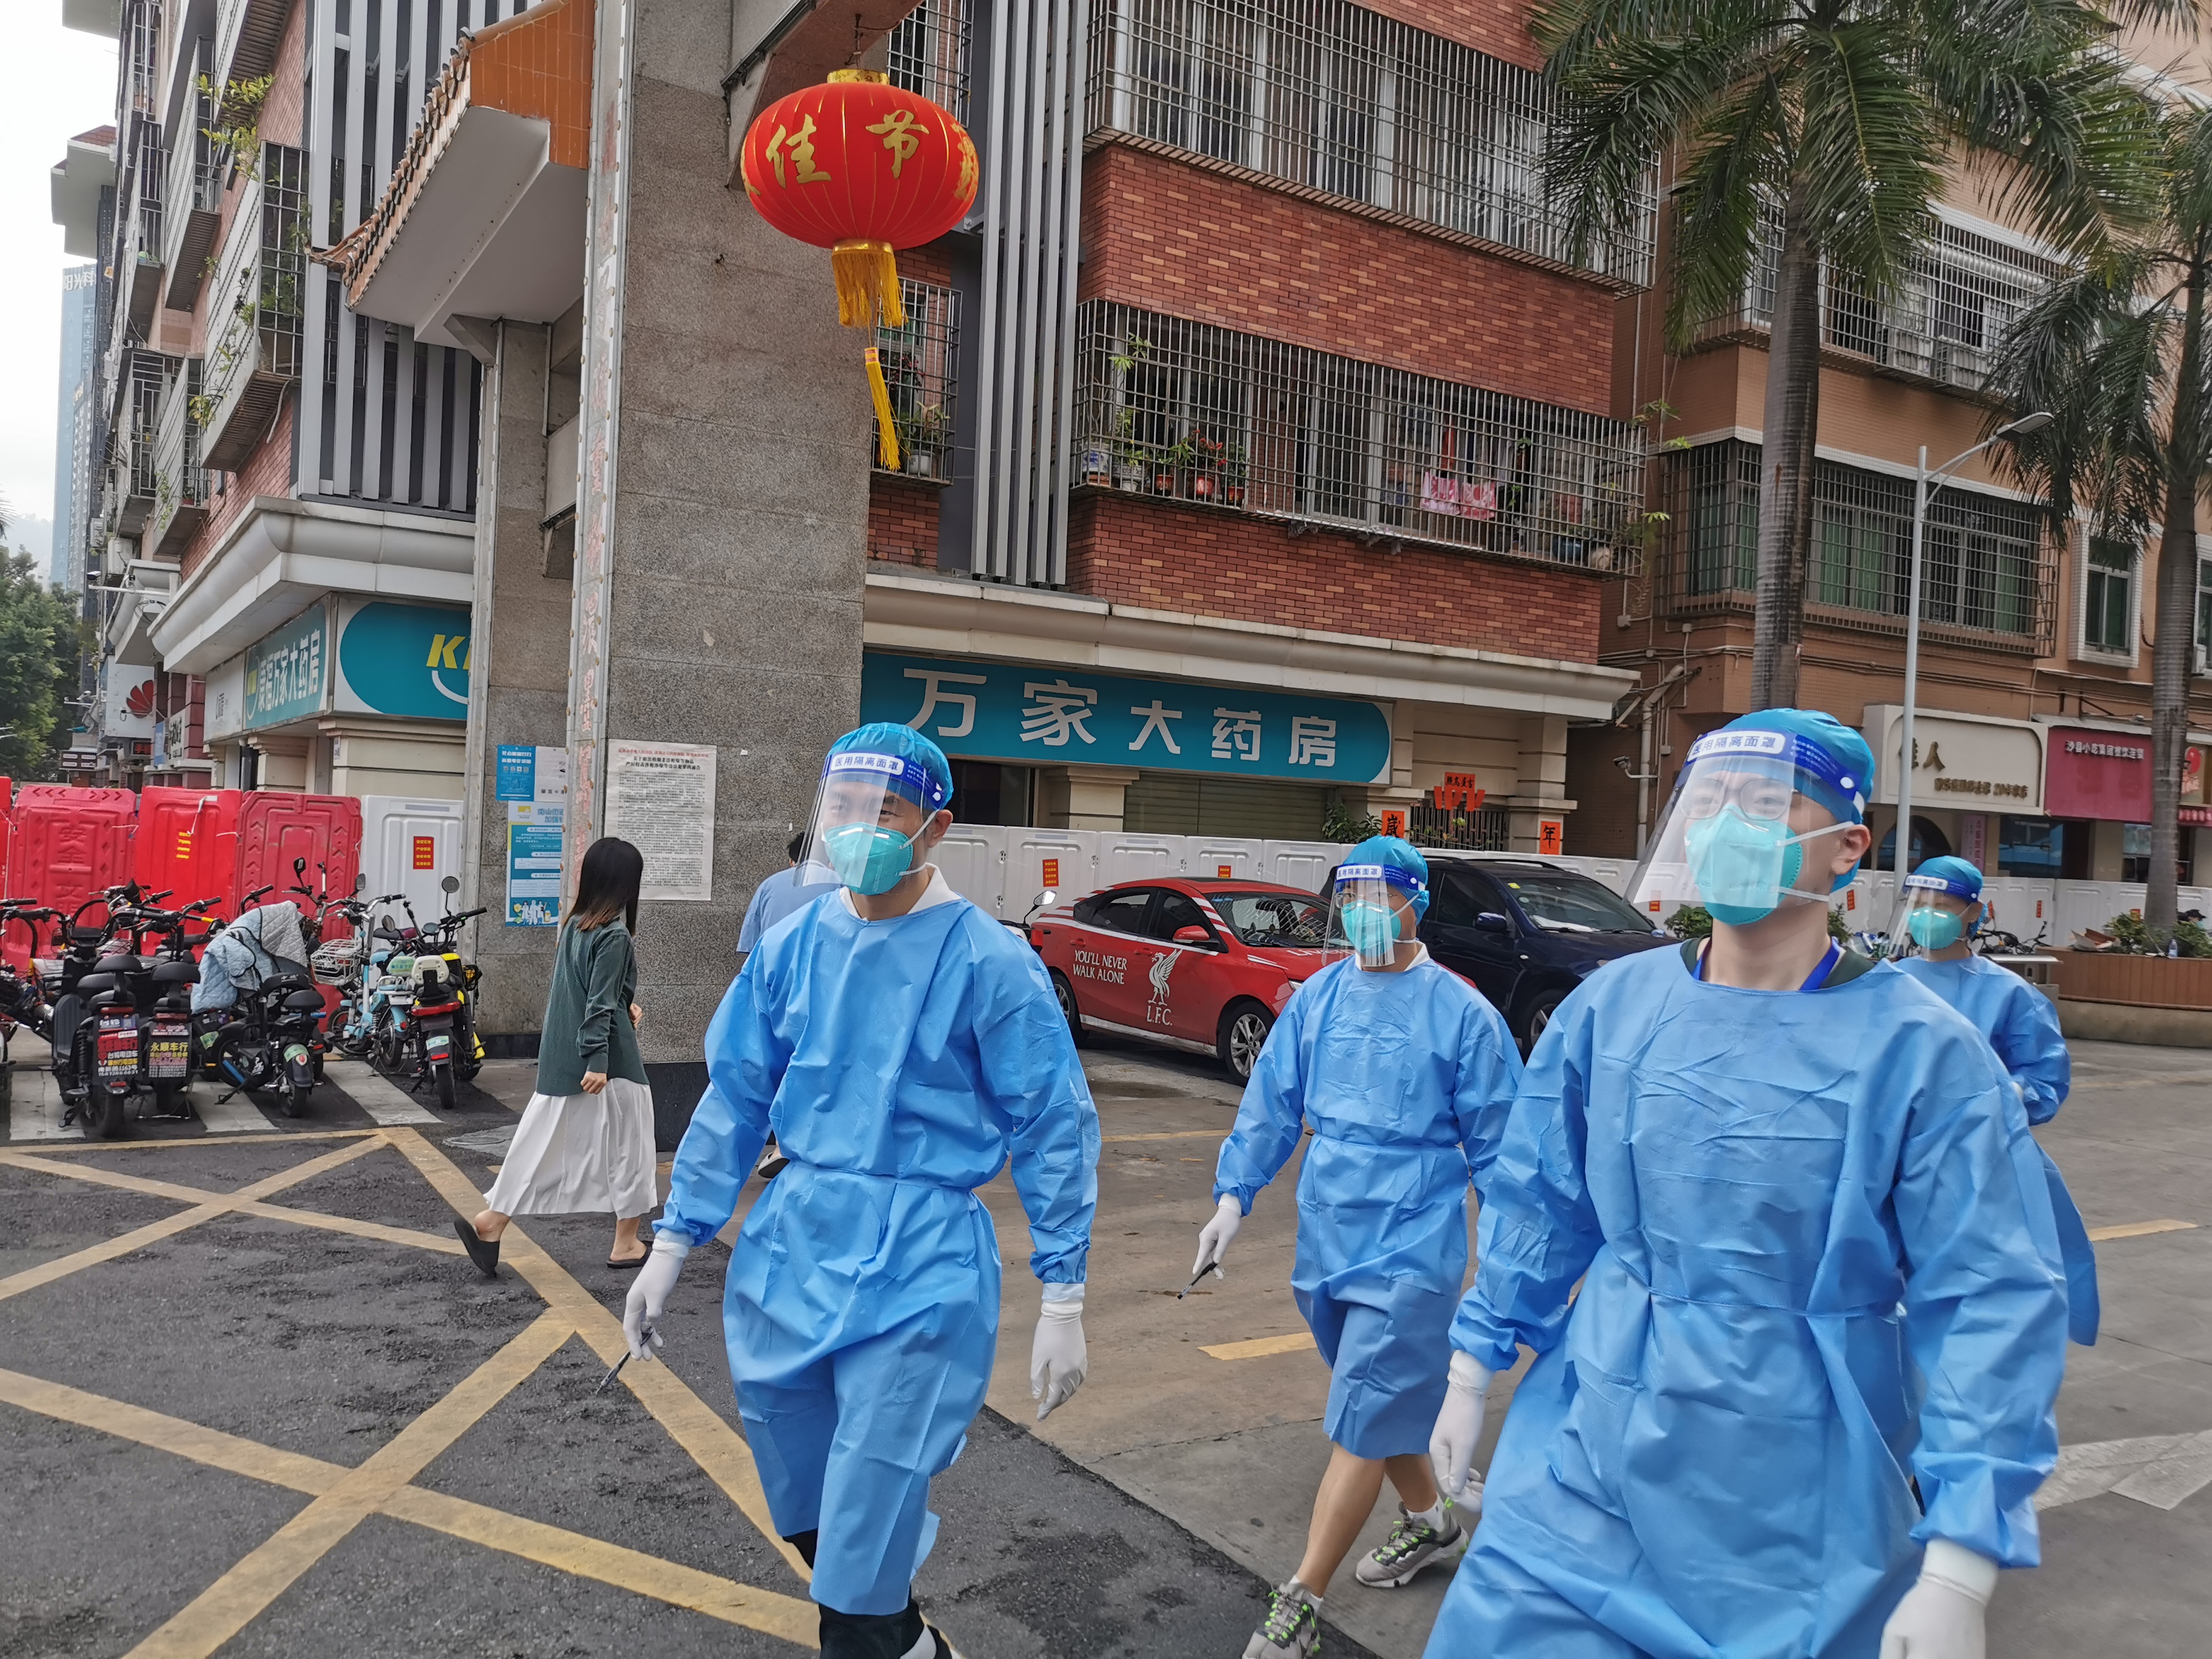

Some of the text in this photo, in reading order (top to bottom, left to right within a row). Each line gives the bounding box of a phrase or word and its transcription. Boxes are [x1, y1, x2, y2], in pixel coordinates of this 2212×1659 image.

[765, 109, 929, 189] 佳节
[64, 270, 97, 290] 阳光科
[426, 634, 470, 670] K
[903, 668, 1336, 767] 万家大药房
[1692, 735, 1776, 755] 医用隔离面罩
[2066, 740, 2144, 759] 沙县小吃集团餐饮连锁
[834, 756, 899, 771] 医用隔离面罩
[1543, 826, 1556, 848] 年
[1075, 950, 1127, 970] YOU'LL NEVER
[1073, 964, 1125, 985] WALK ALONE
[1147, 1005, 1173, 1026] L.F.C.
[150, 1042, 189, 1052] 永顺车行
